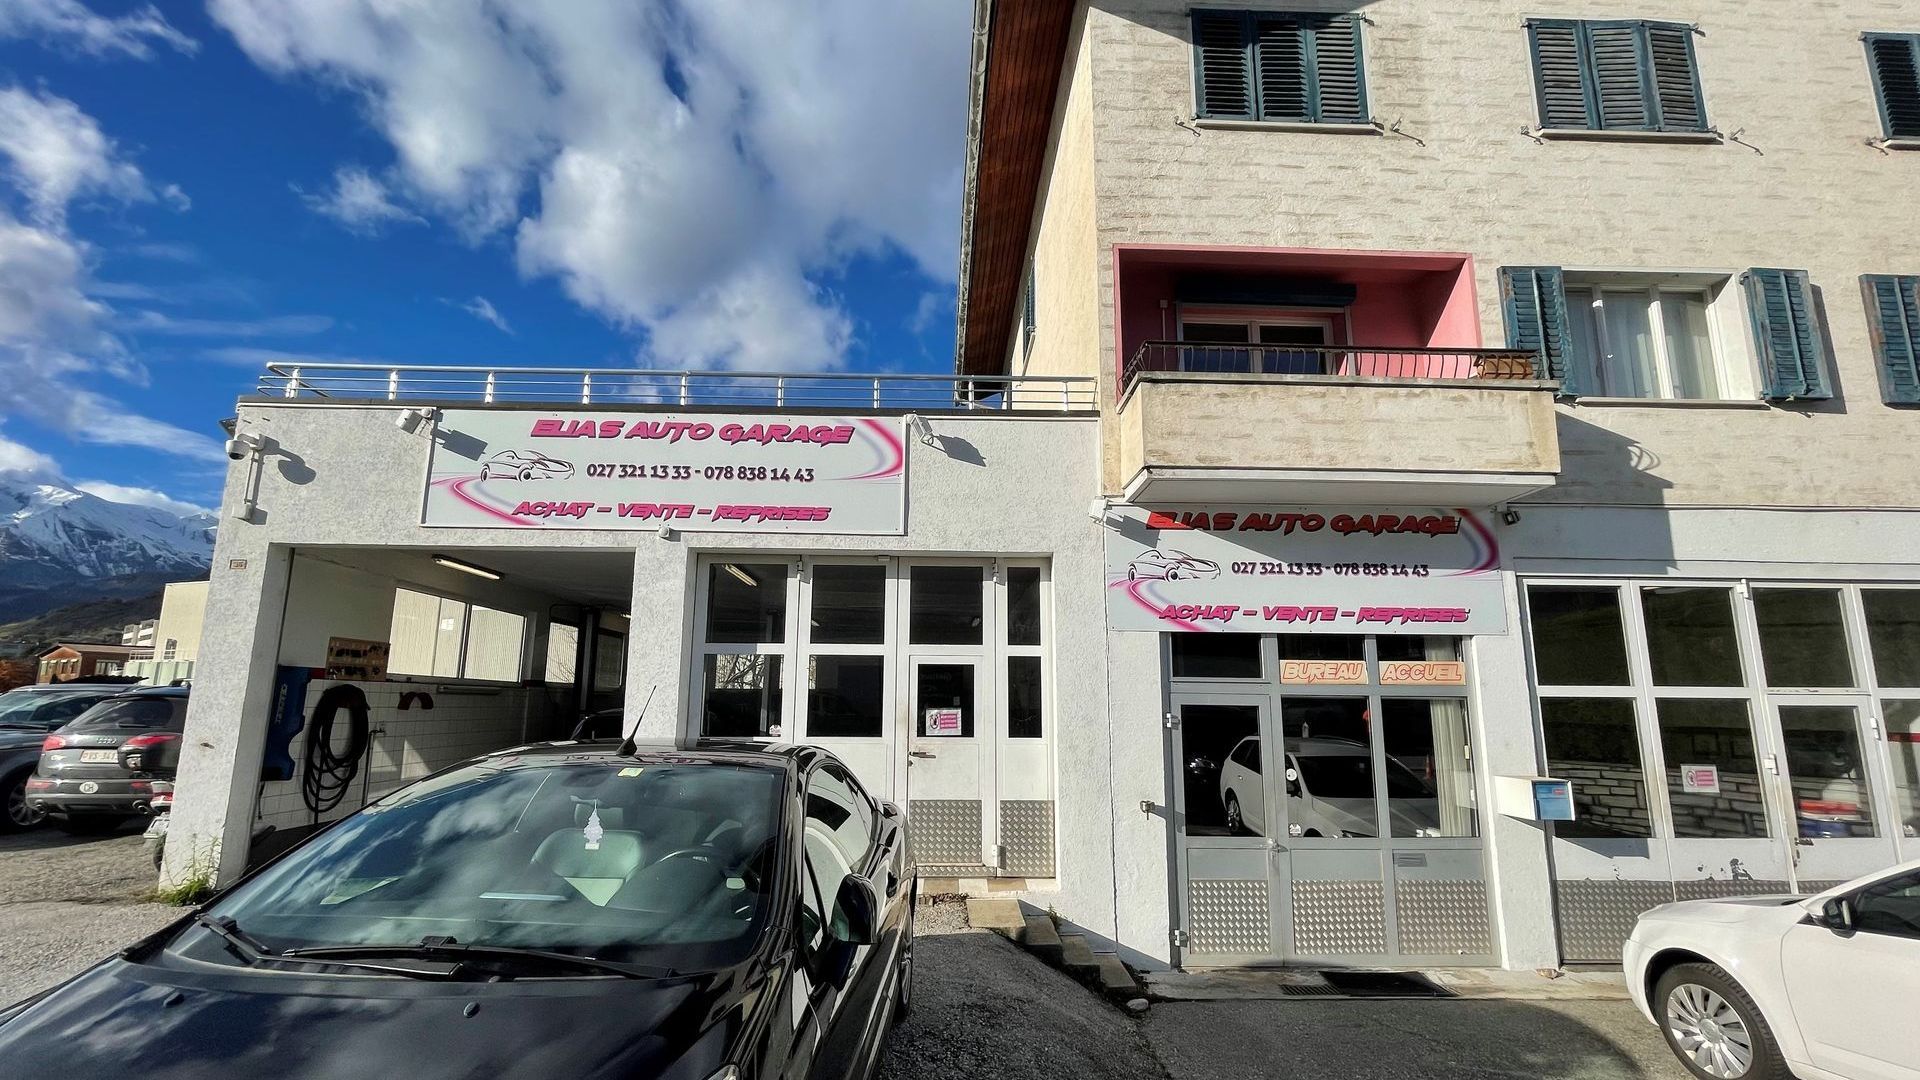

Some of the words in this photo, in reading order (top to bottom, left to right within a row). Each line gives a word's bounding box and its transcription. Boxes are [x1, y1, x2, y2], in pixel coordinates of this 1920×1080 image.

[531, 419, 625, 438] ELIAS
[624, 421, 714, 444] AUTO
[719, 423, 855, 447] GARAGE
[586, 463, 616, 478] 027
[618, 464, 647, 478] 321
[650, 465, 669, 479] 13
[671, 465, 691, 480] 33
[704, 465, 734, 480] 078
[737, 466, 767, 481] 838
[770, 467, 791, 482] 14
[794, 468, 815, 482] 43
[511, 501, 595, 519] ACHAT
[617, 503, 695, 521] VENTE
[711, 504, 832, 523] REPRISES
[1146, 511, 1238, 531] ELIAS
[1238, 513, 1326, 536] AUTO
[1330, 514, 1462, 538] GARAGE
[1231, 561, 1257, 575] 027
[1259, 562, 1285, 576] 321
[1287, 562, 1304, 576] 13
[1306, 562, 1323, 576] 33
[1333, 562, 1360, 576] 078
[1362, 562, 1388, 577] 838
[1391, 563, 1409, 577] 14
[1412, 564, 1430, 577] 43
[1159, 605, 1240, 623] ACHAT
[1262, 606, 1338, 624] VENTE
[1355, 607, 1471, 625] REPRISES
[1283, 662, 1363, 683] BUREAU
[1382, 663, 1462, 682] ACCUEIL
